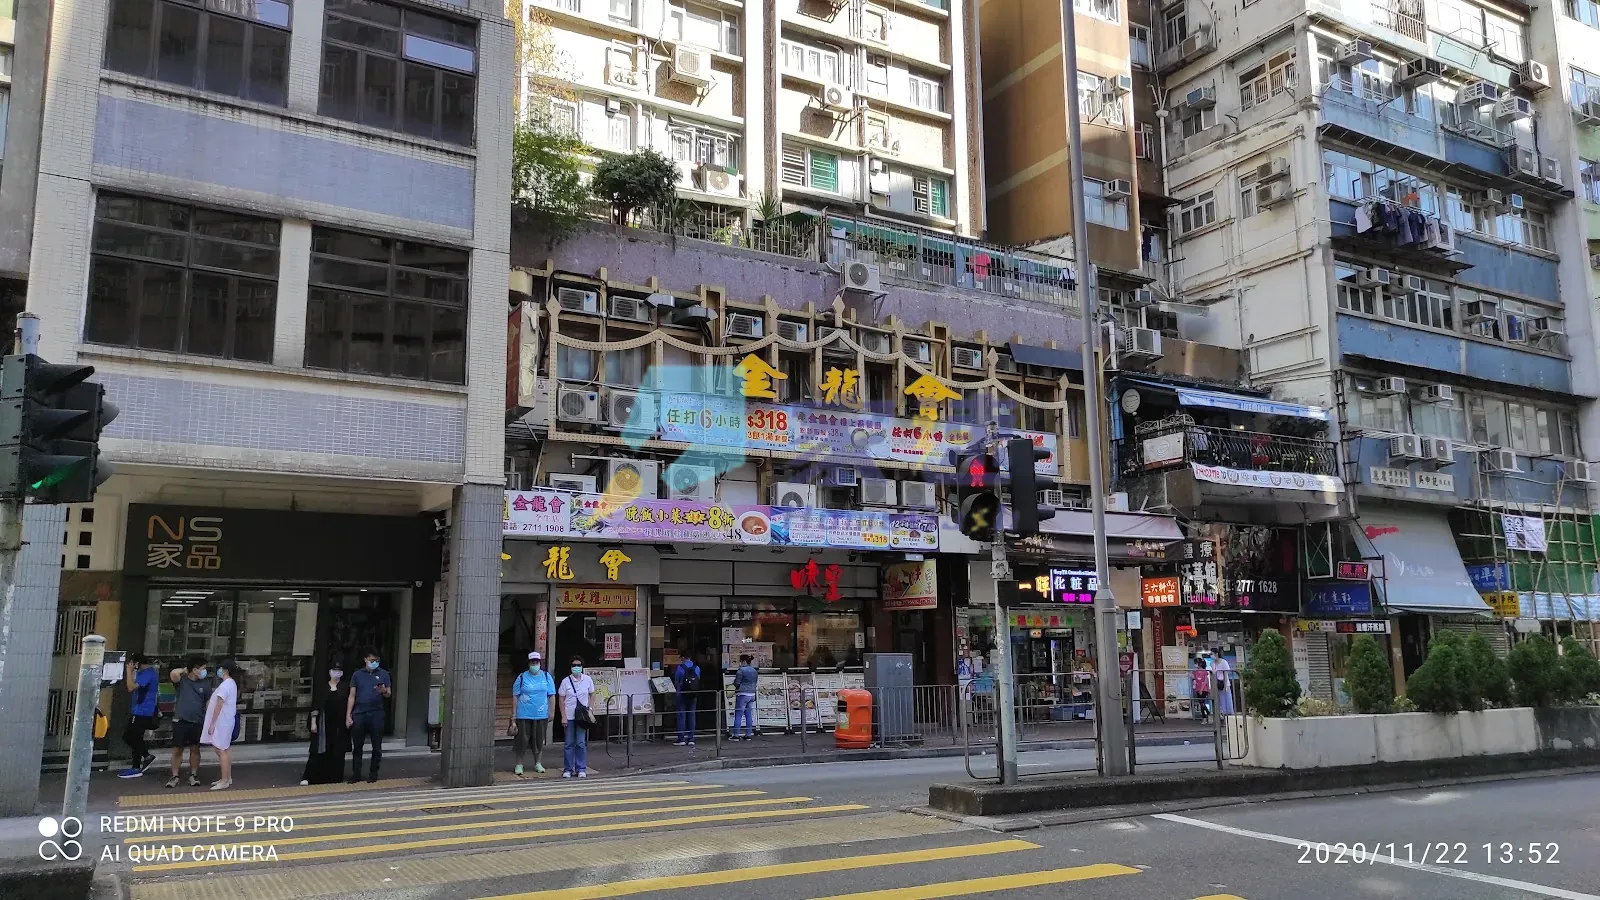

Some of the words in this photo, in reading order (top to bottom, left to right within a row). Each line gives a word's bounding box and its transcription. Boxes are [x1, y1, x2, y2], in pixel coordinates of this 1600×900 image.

[734, 353, 963, 421] 金龍會
[667, 408, 741, 431] 任打6小時
[747, 409, 788, 431] $318
[512, 494, 565, 514] 金龍會
[147, 514, 223, 541] NS
[522, 523, 542, 532] 2711
[545, 525, 564, 533] 1908
[146, 542, 222, 569] 家品
[501, 546, 631, 581] 龍會
[1053, 576, 1098, 591] 化粧品
[1236, 579, 1255, 593] 2777
[1258, 581, 1278, 594] 1628
